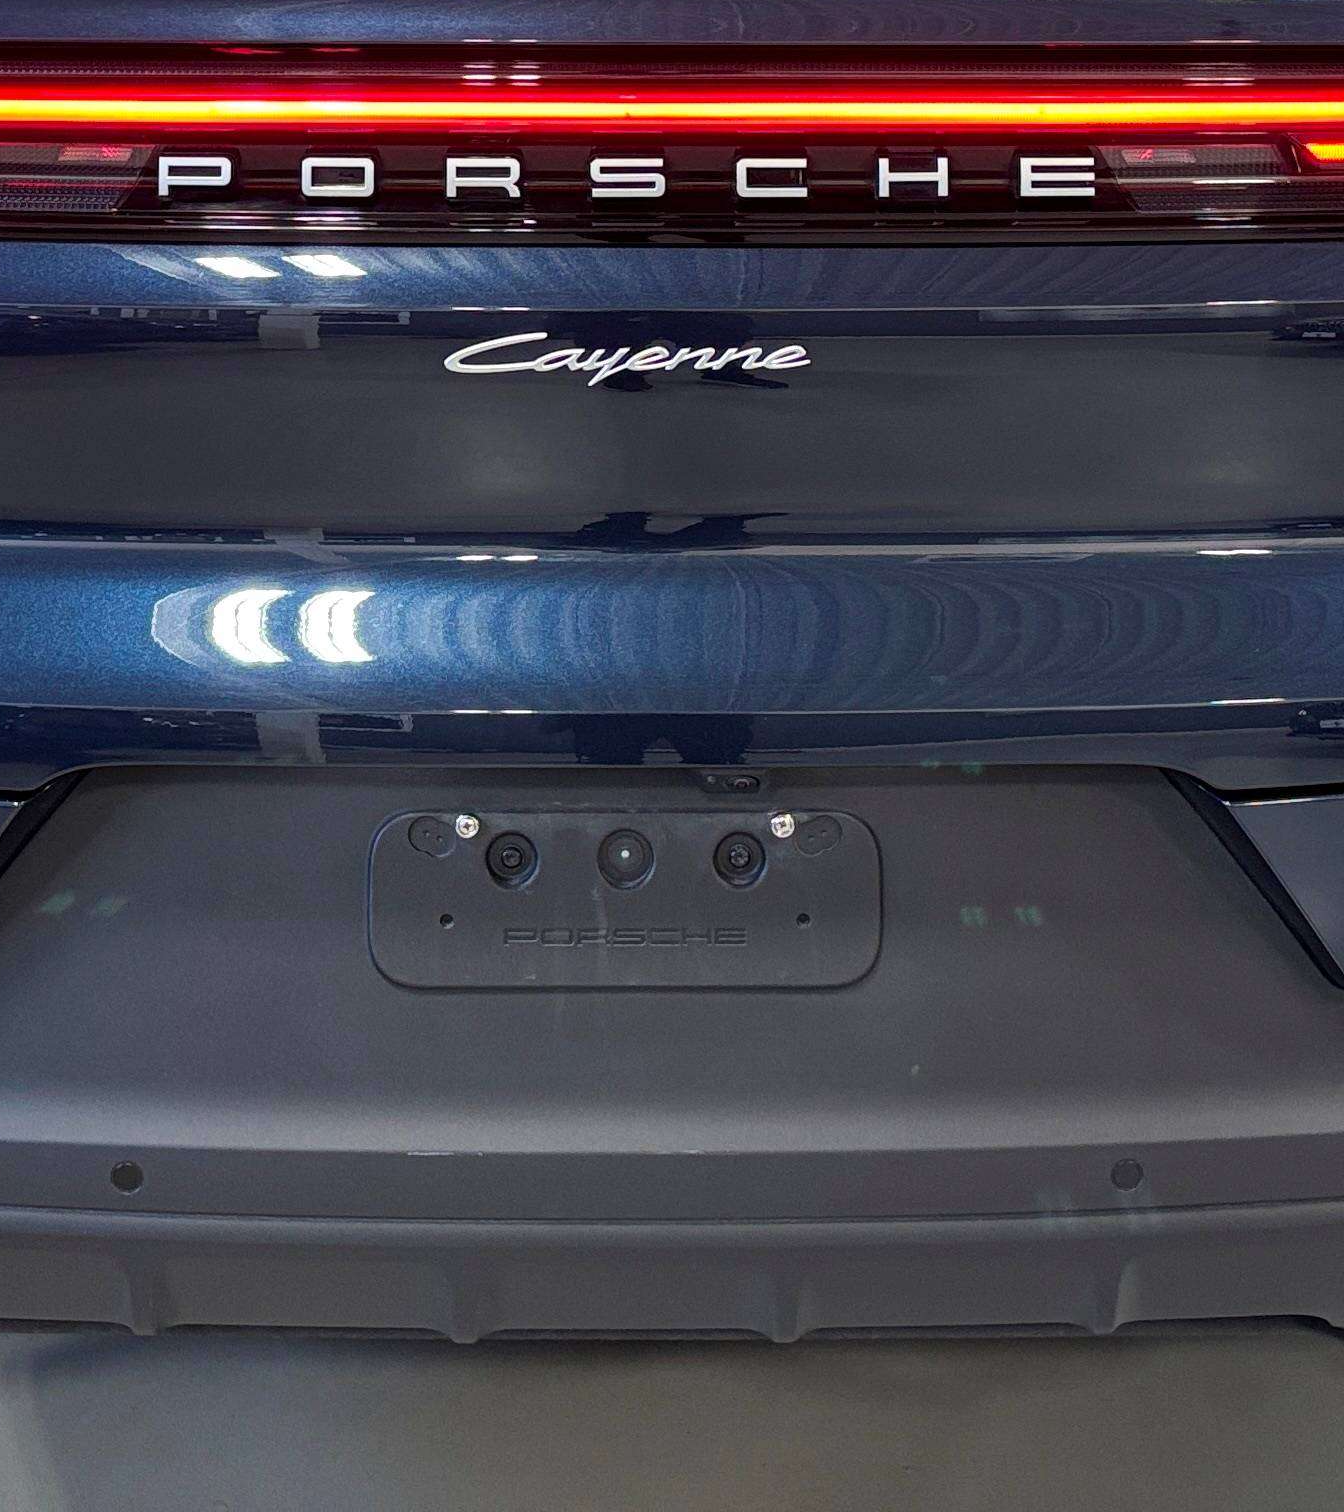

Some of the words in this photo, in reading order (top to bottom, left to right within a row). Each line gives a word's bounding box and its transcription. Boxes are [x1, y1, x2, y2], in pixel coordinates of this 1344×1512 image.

[158, 156, 1096, 199] PORSCHE
[443, 330, 812, 386] Cayenne
[503, 926, 748, 949] PORSCHE
